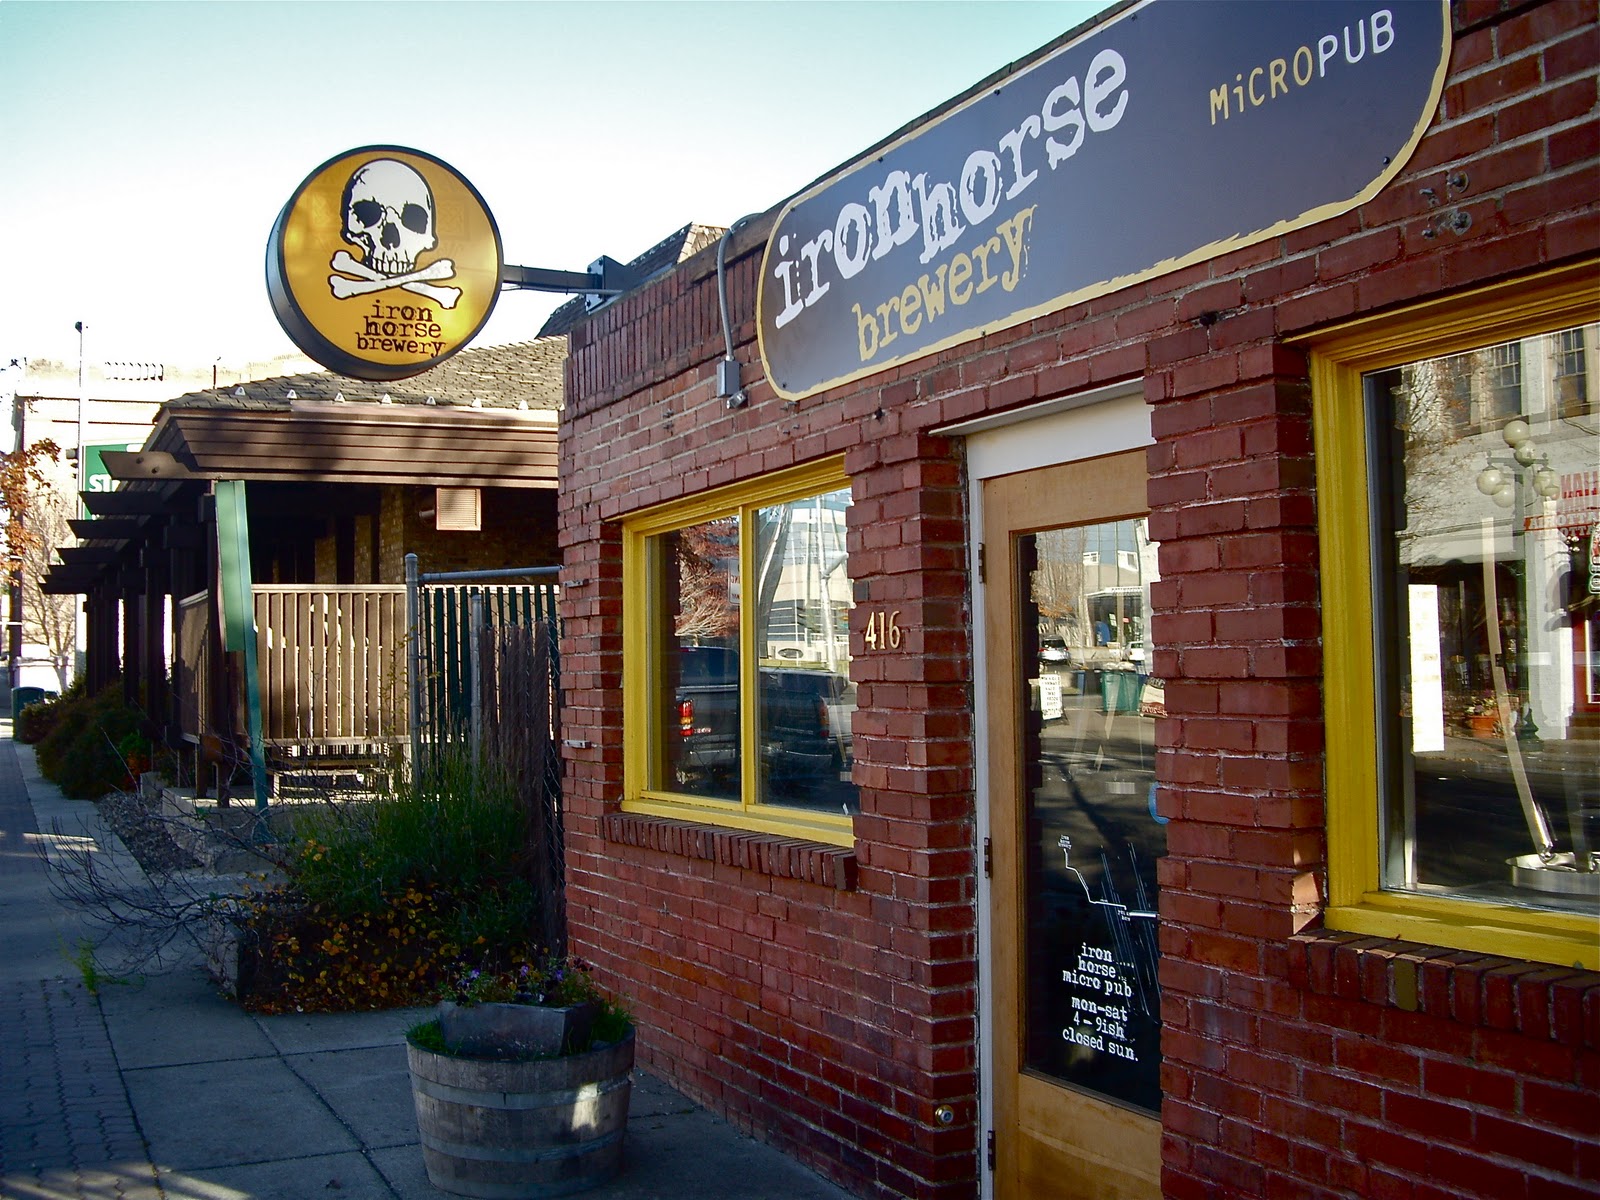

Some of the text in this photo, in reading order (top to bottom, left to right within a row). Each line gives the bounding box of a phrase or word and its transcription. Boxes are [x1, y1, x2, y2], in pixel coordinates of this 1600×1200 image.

[852, 204, 1038, 361] brewery
[371, 299, 433, 322] iron
[363, 315, 441, 338] horse
[355, 332, 447, 358] brewery
[865, 611, 900, 650] 416
[1081, 942, 1113, 962] iron
[1078, 955, 1116, 978] horse
[1062, 970, 1132, 997] micro pub
[1071, 997, 1128, 1021] mon-sat
[1062, 1027, 1139, 1061] closed sun.
